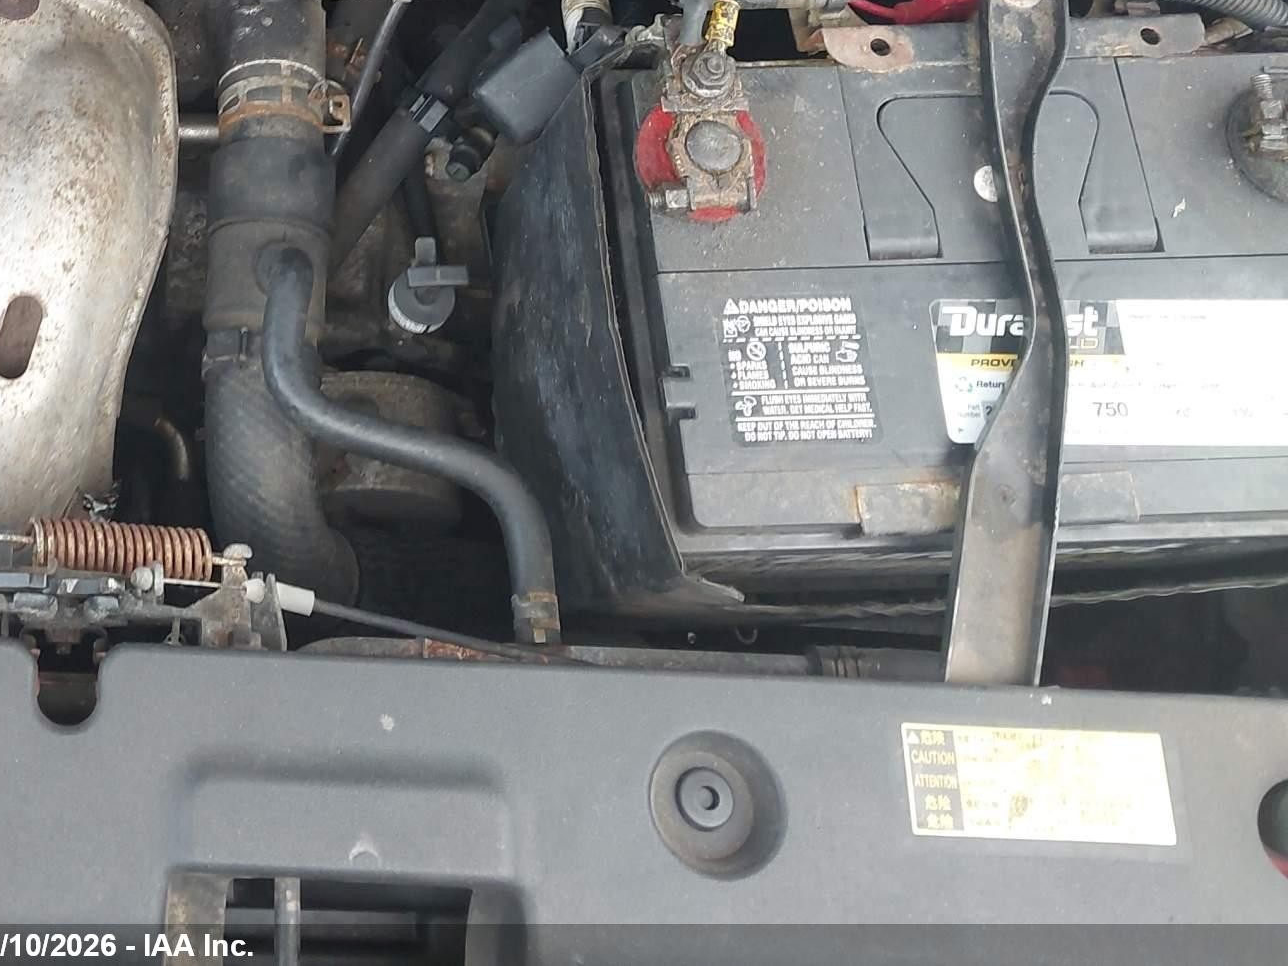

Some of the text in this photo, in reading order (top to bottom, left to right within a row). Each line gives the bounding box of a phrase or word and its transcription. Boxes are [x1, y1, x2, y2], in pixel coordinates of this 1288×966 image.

[738, 297, 852, 315] DANGER/POISON
[940, 305, 1100, 338] Durast
[813, 353, 830, 364] CAN
[819, 364, 863, 375] BLINDNESS
[1092, 401, 1129, 417] 750
[911, 749, 955, 765] CAUTION
[914, 774, 957, 789] ATTENTION
